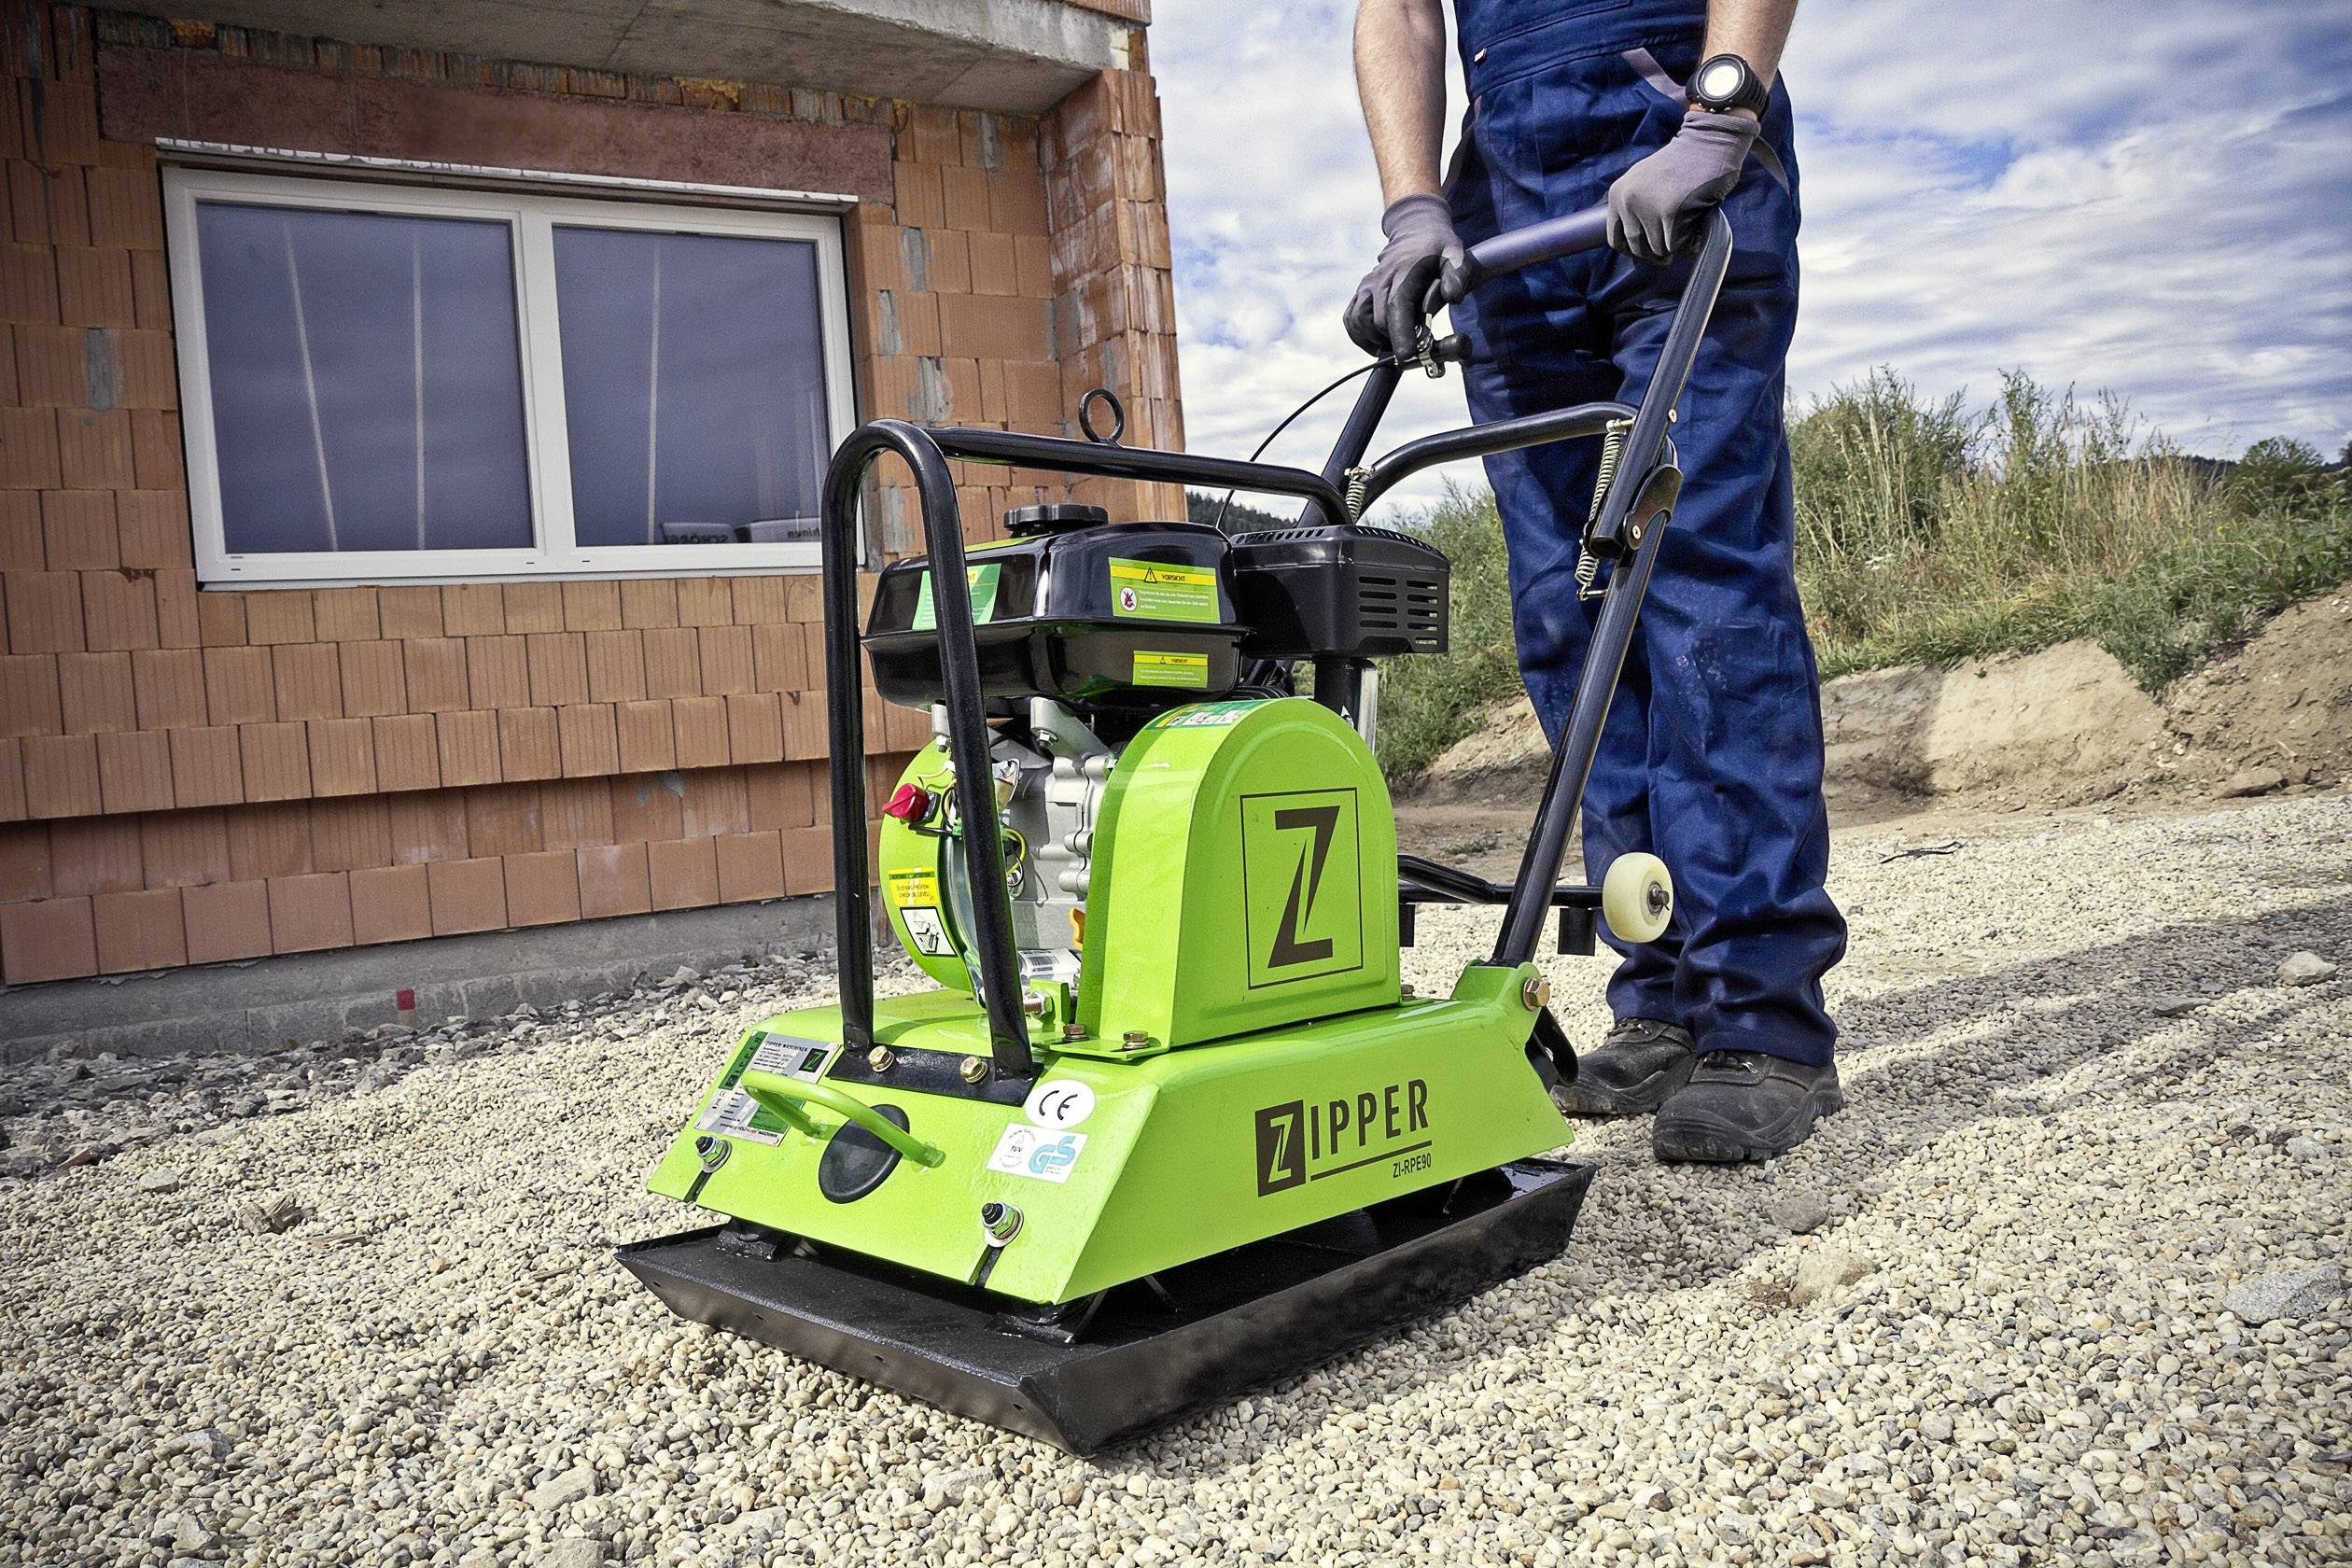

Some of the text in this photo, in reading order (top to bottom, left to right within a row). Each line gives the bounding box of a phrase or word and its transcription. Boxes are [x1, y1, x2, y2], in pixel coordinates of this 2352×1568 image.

[1162, 574, 1186, 582] VORSICHT
[1038, 1089, 1079, 1121] CE
[1260, 1078, 1429, 1189] ZIPPER
[1393, 1152, 1432, 1179] ZI-RPE90
